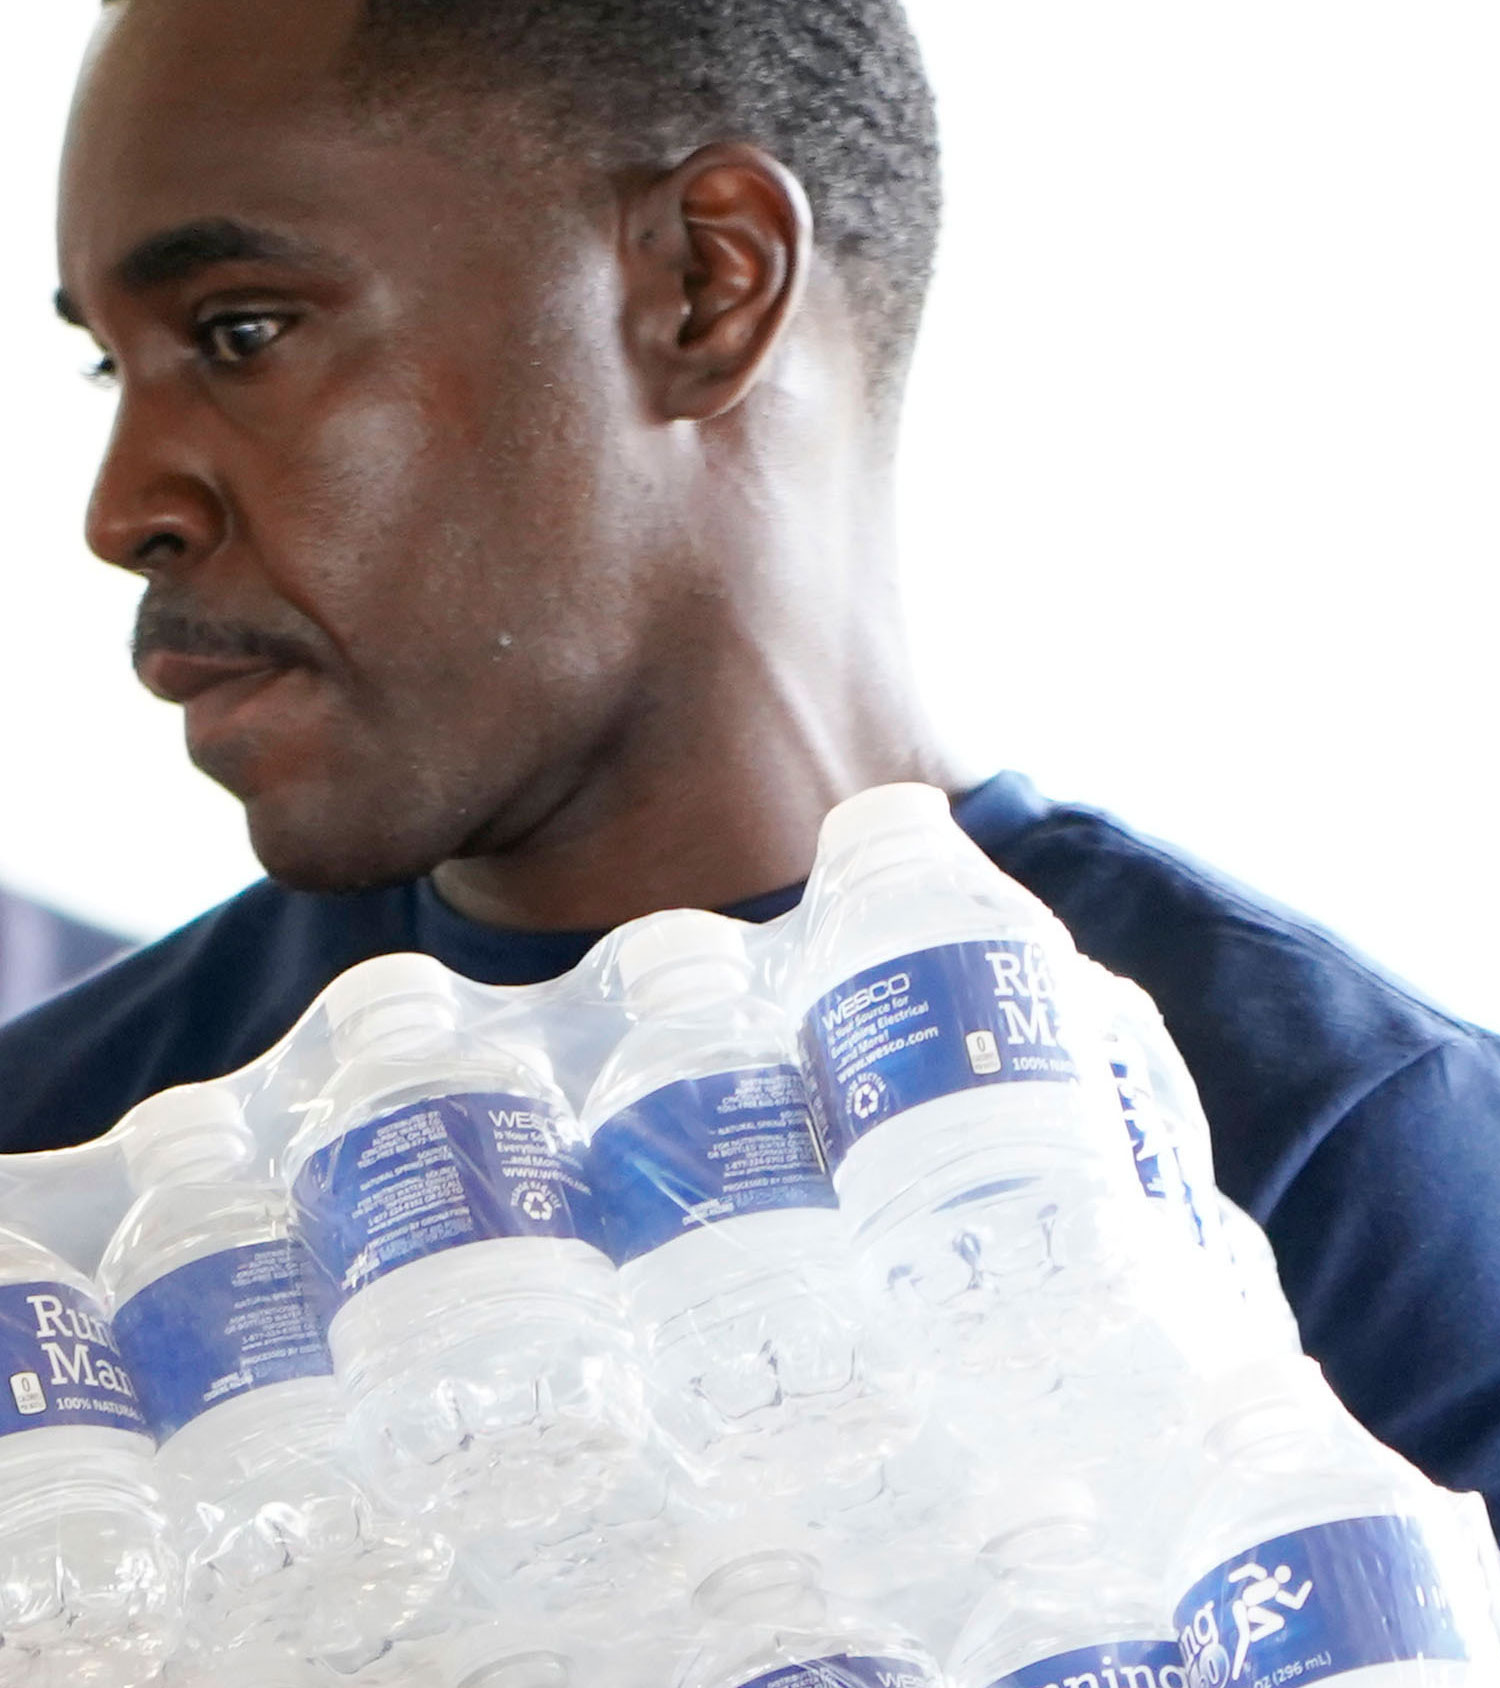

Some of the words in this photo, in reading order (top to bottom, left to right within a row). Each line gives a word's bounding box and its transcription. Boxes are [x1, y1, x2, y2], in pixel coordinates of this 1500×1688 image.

[821, 973, 910, 1030] WESCO
[855, 1002, 890, 1025] Source
[891, 994, 909, 1007] for
[877, 1001, 929, 1029] Electrical
